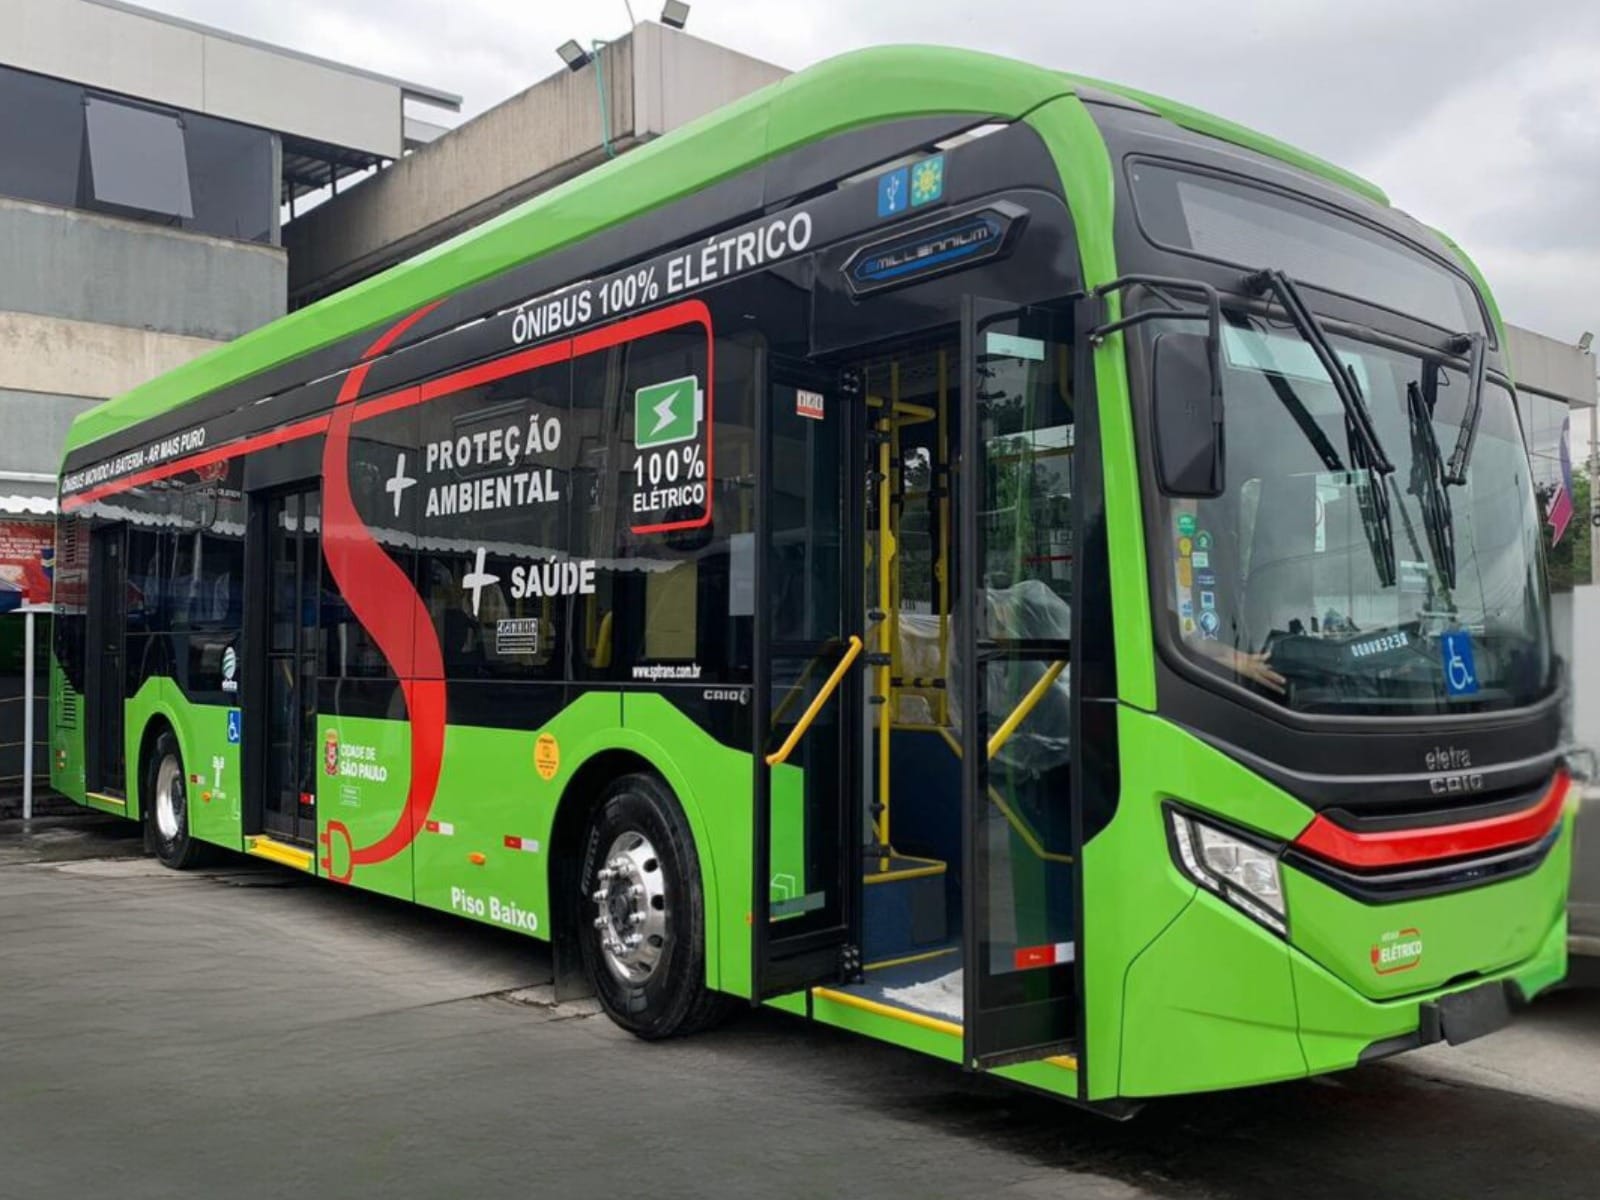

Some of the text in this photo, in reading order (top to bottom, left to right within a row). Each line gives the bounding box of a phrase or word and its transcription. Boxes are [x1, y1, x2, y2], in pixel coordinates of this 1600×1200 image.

[511, 212, 813, 344] ÔNIBUS 100% ELÉTRICO
[160, 438, 181, 458] MAIS
[181, 427, 206, 451] PURO
[426, 413, 562, 473] PROTEÇÃO
[633, 444, 705, 487] 100%
[425, 469, 560, 518] AMBIENTAL
[633, 484, 705, 512] ELÉTRICO
[510, 555, 596, 599] SAÚDE
[340, 758, 387, 782] SÃO PAULO
[341, 744, 376, 761] CIDADE DE
[1425, 746, 1472, 771] eletra
[451, 886, 538, 931] Piso Baixo
[1380, 940, 1422, 963] ELÉTRICO
